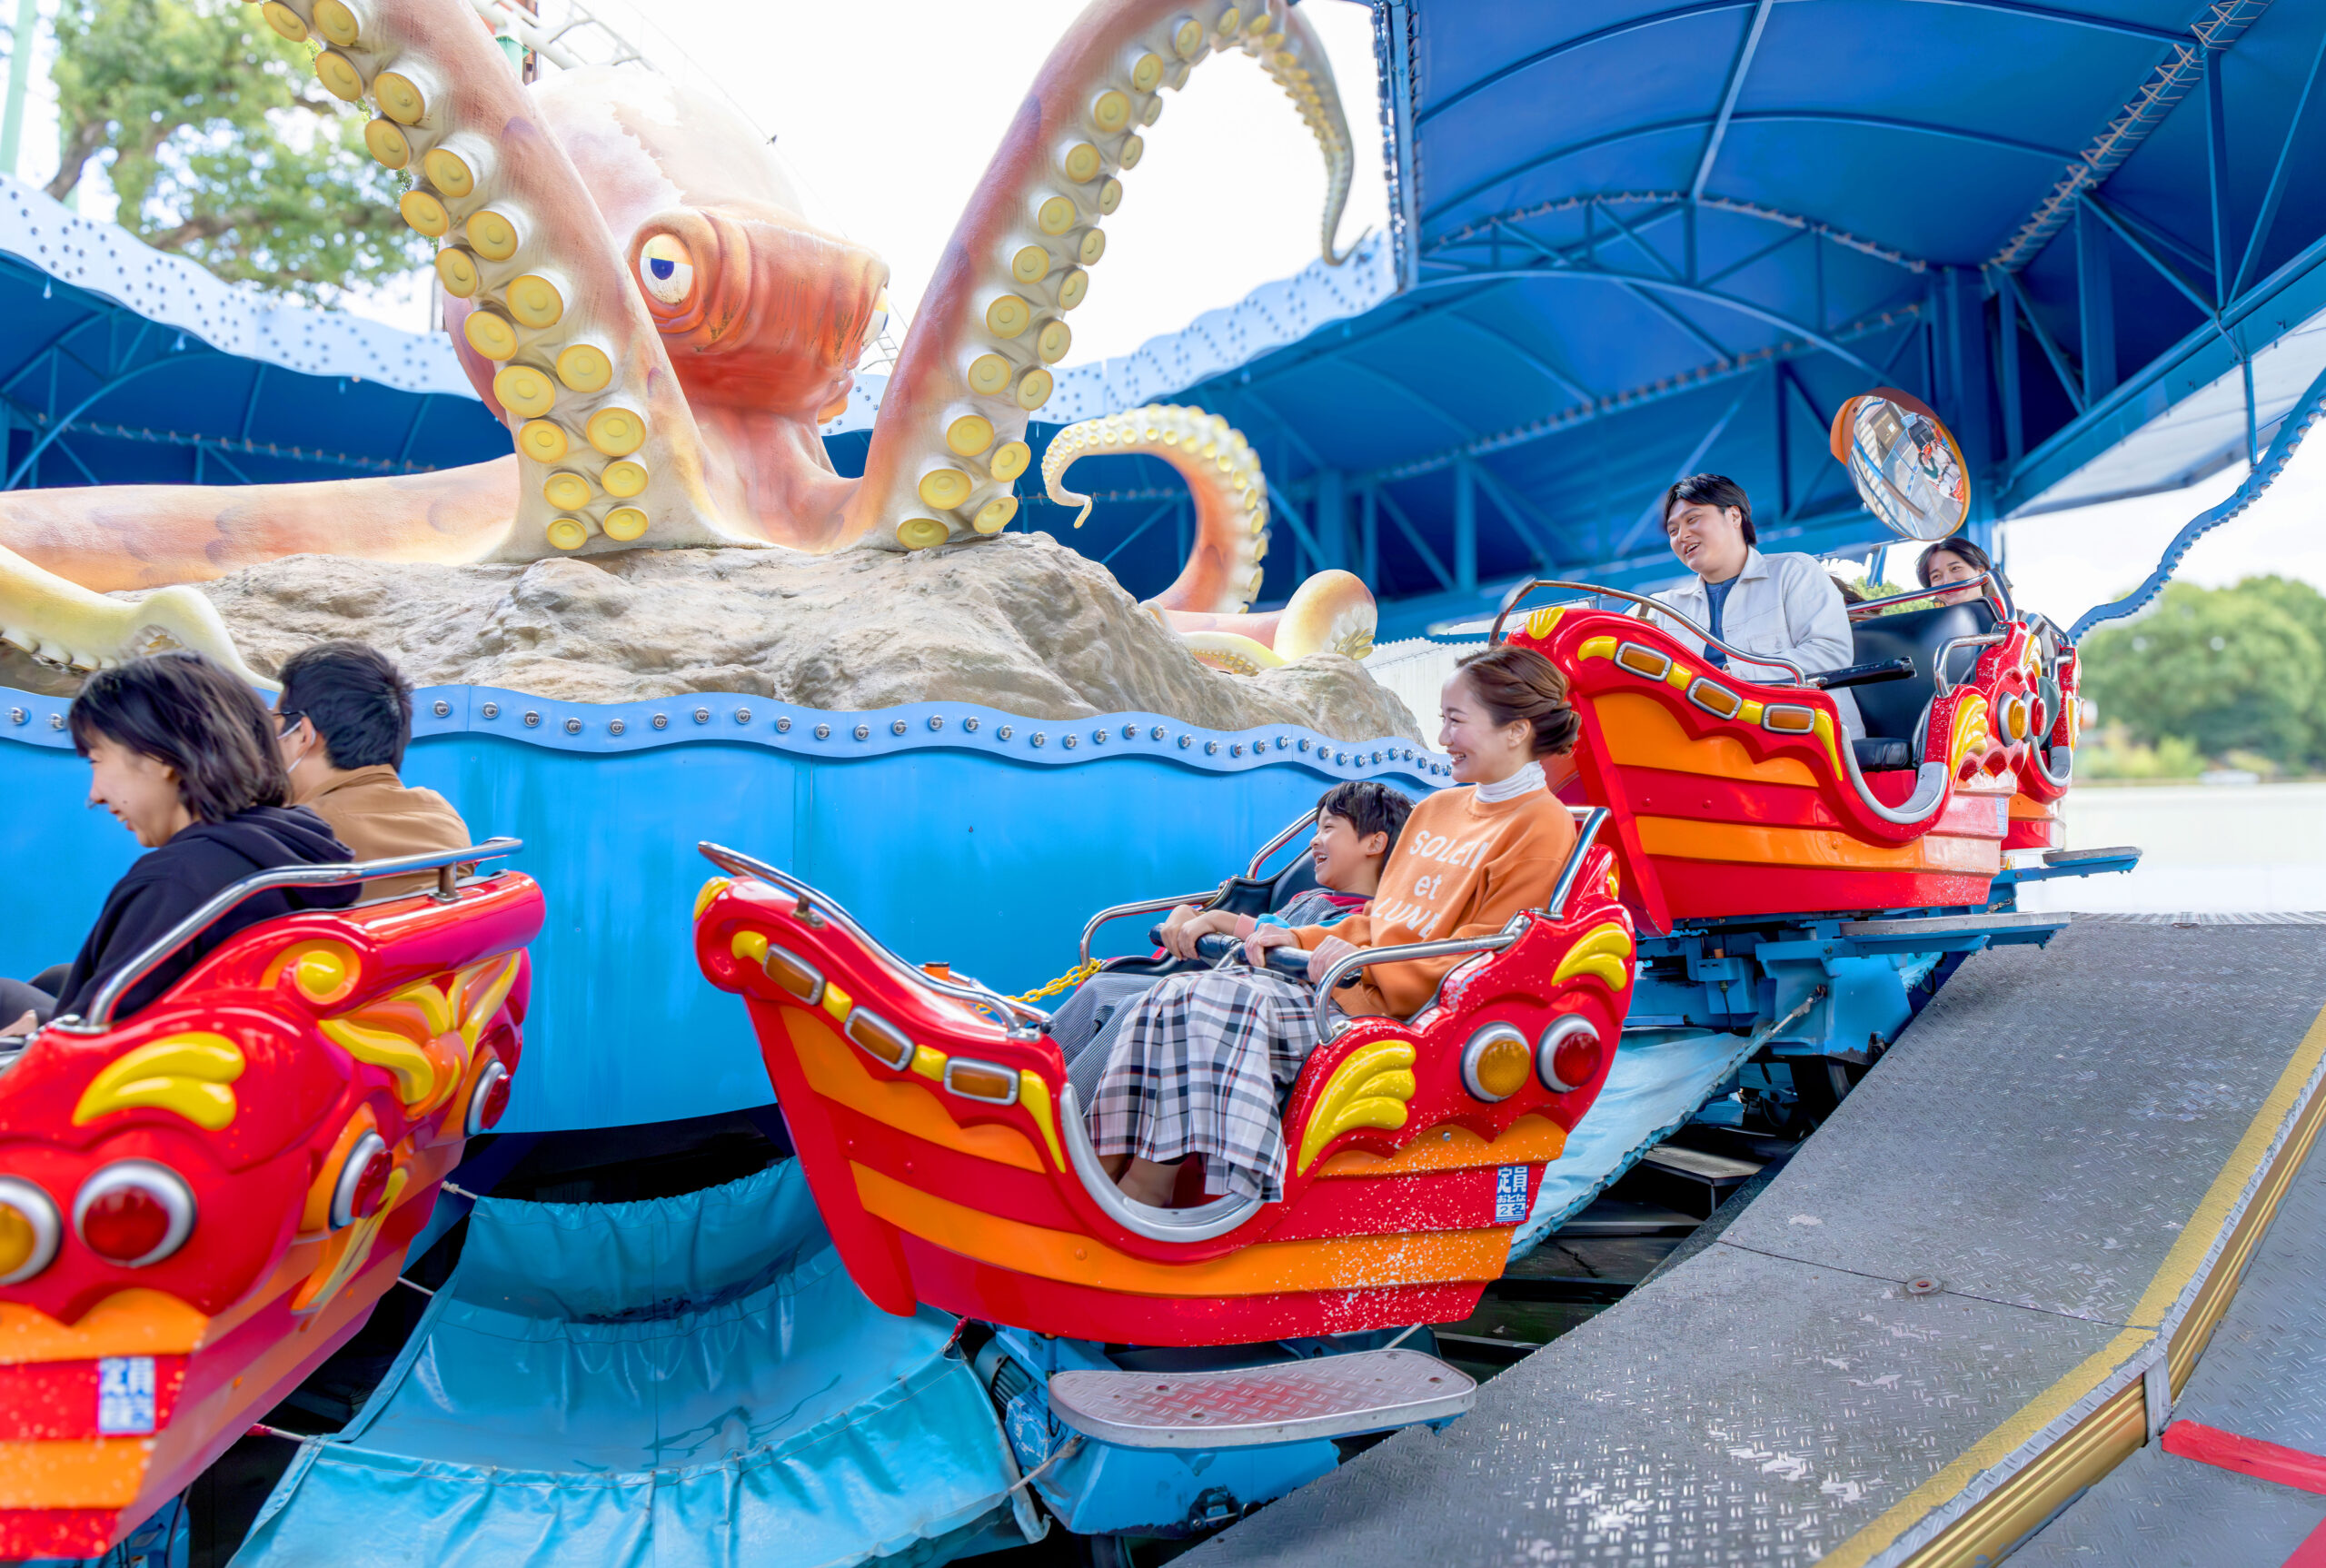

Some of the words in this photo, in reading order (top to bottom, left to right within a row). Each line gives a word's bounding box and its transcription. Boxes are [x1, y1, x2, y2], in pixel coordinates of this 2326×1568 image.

[1414, 875, 1442, 900] et
[1497, 1166, 1527, 1194] 定員
[1496, 1194, 1526, 1204] おとな
